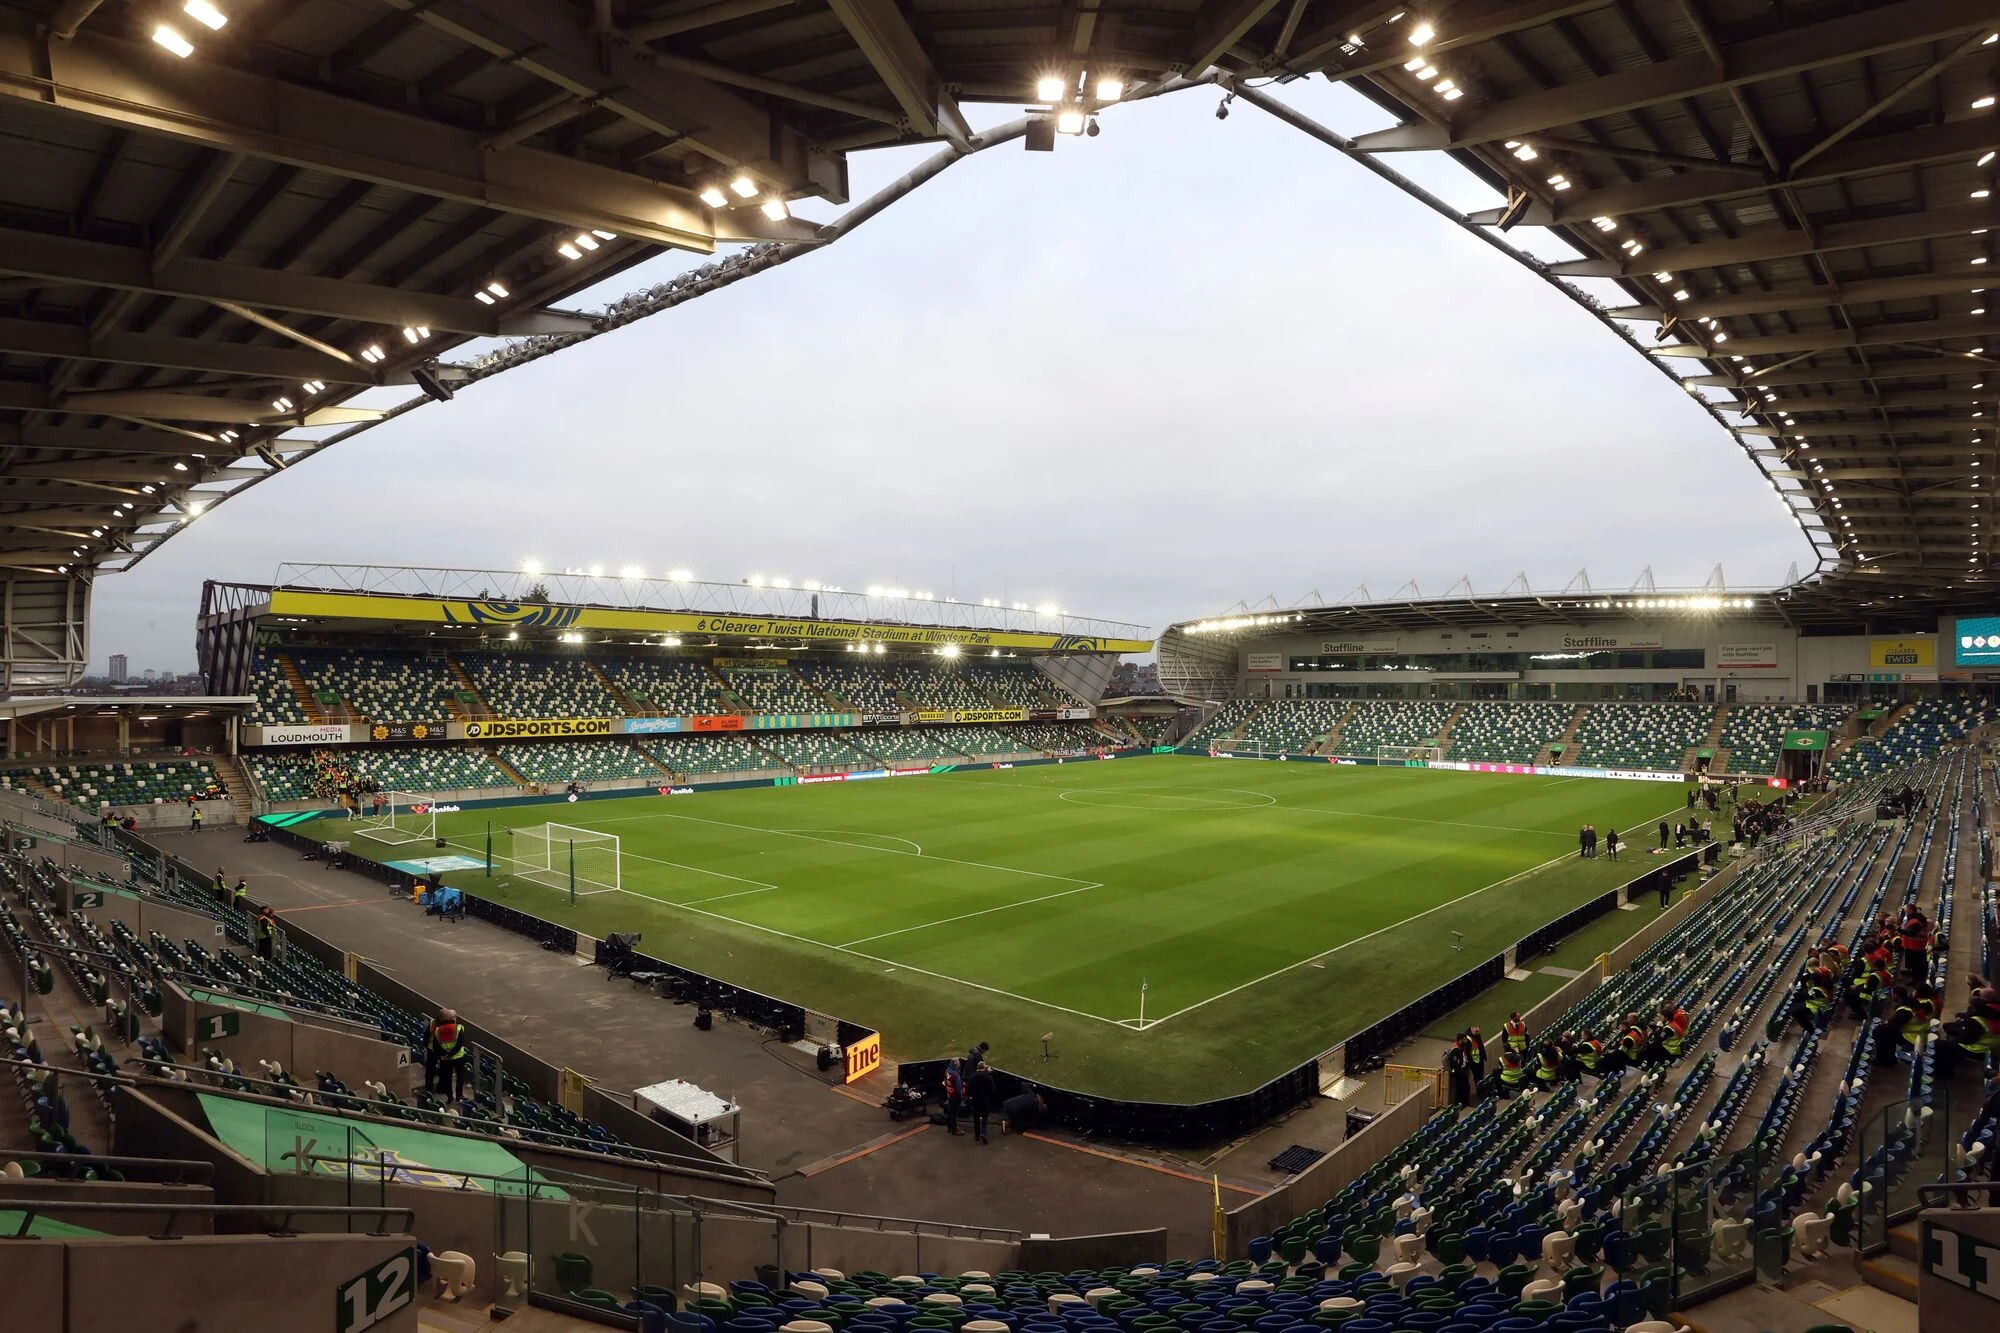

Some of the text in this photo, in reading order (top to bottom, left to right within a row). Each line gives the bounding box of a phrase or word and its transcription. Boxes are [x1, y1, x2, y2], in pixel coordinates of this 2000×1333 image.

[710, 619, 991, 643] Clearer Twist National Stadium at Windsor Park
[1324, 643, 1364, 652] Staffline
[1564, 637, 1617, 647] Staffline
[1886, 655, 1916, 663] TWIST
[963, 712, 1021, 721] JDSPORTS.COM
[484, 720, 610, 736] JDSPORTS.COM
[271, 733, 343, 743] LOUDMOUTH
[1548, 768, 1605, 777] Volkswagen
[21, 839, 32, 848] 3
[82, 893, 97, 908] 2
[211, 1016, 227, 1038] 1
[400, 1054, 407, 1064] A
[295, 1121, 315, 1132] BLOCK
[295, 1135, 318, 1177] K
[569, 1195, 600, 1246] K
[1932, 1228, 2000, 1301] 11
[344, 1256, 410, 1333] 12
